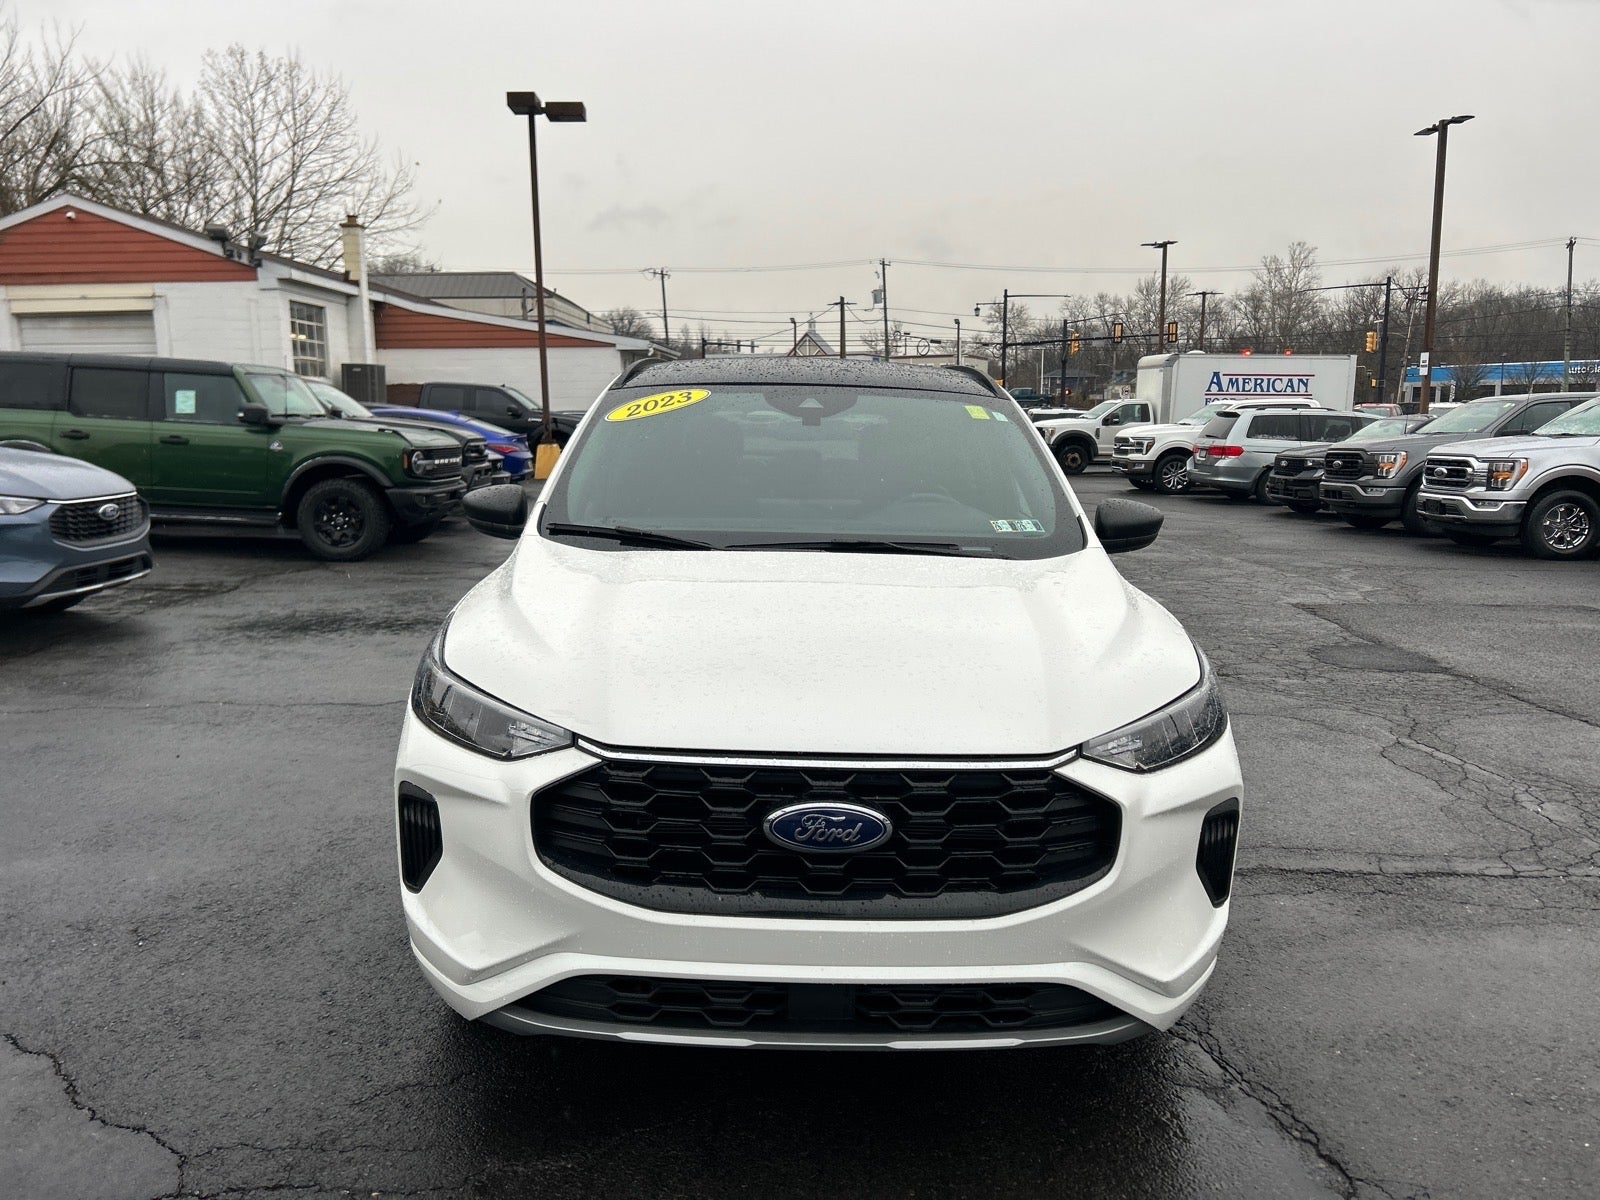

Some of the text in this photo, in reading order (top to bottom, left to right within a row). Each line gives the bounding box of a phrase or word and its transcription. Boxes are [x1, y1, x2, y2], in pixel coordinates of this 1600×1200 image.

[1206, 371, 1310, 393] AMERICAN
[625, 391, 693, 418] 2023
[794, 813, 863, 841] Ford
